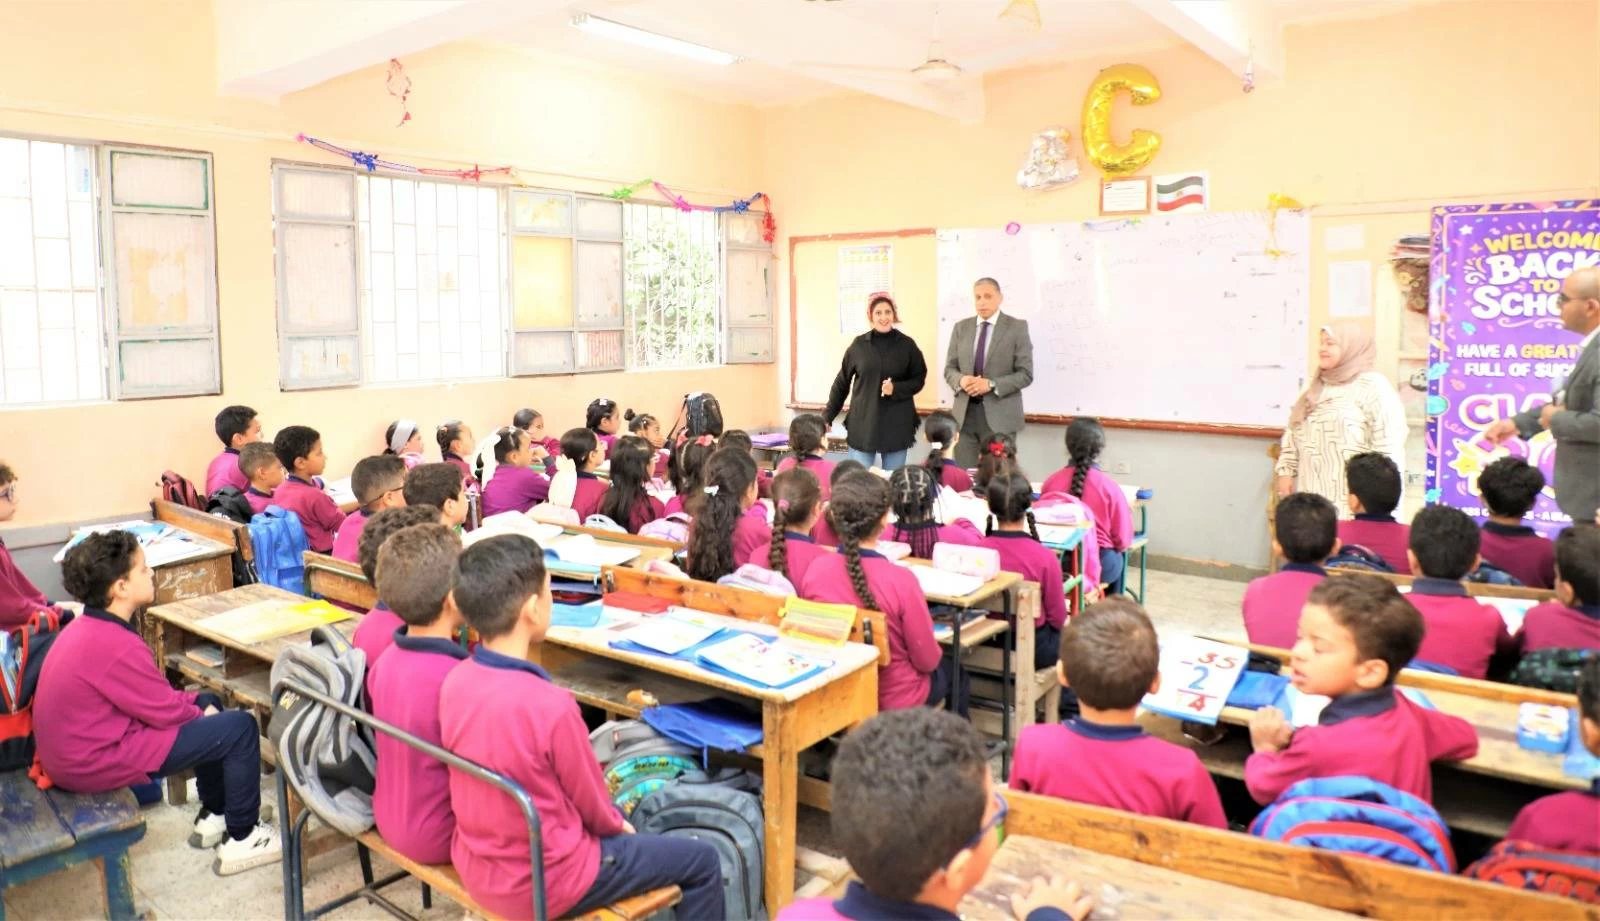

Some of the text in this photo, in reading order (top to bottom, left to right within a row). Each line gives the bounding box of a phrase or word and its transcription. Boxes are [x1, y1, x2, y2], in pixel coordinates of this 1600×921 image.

[1529, 279, 1560, 293] TO
[1471, 285, 1561, 319] SCHO
[1456, 344, 1579, 359] HAVE A GREAT
[1464, 362, 1576, 378] FULL OF SUC
